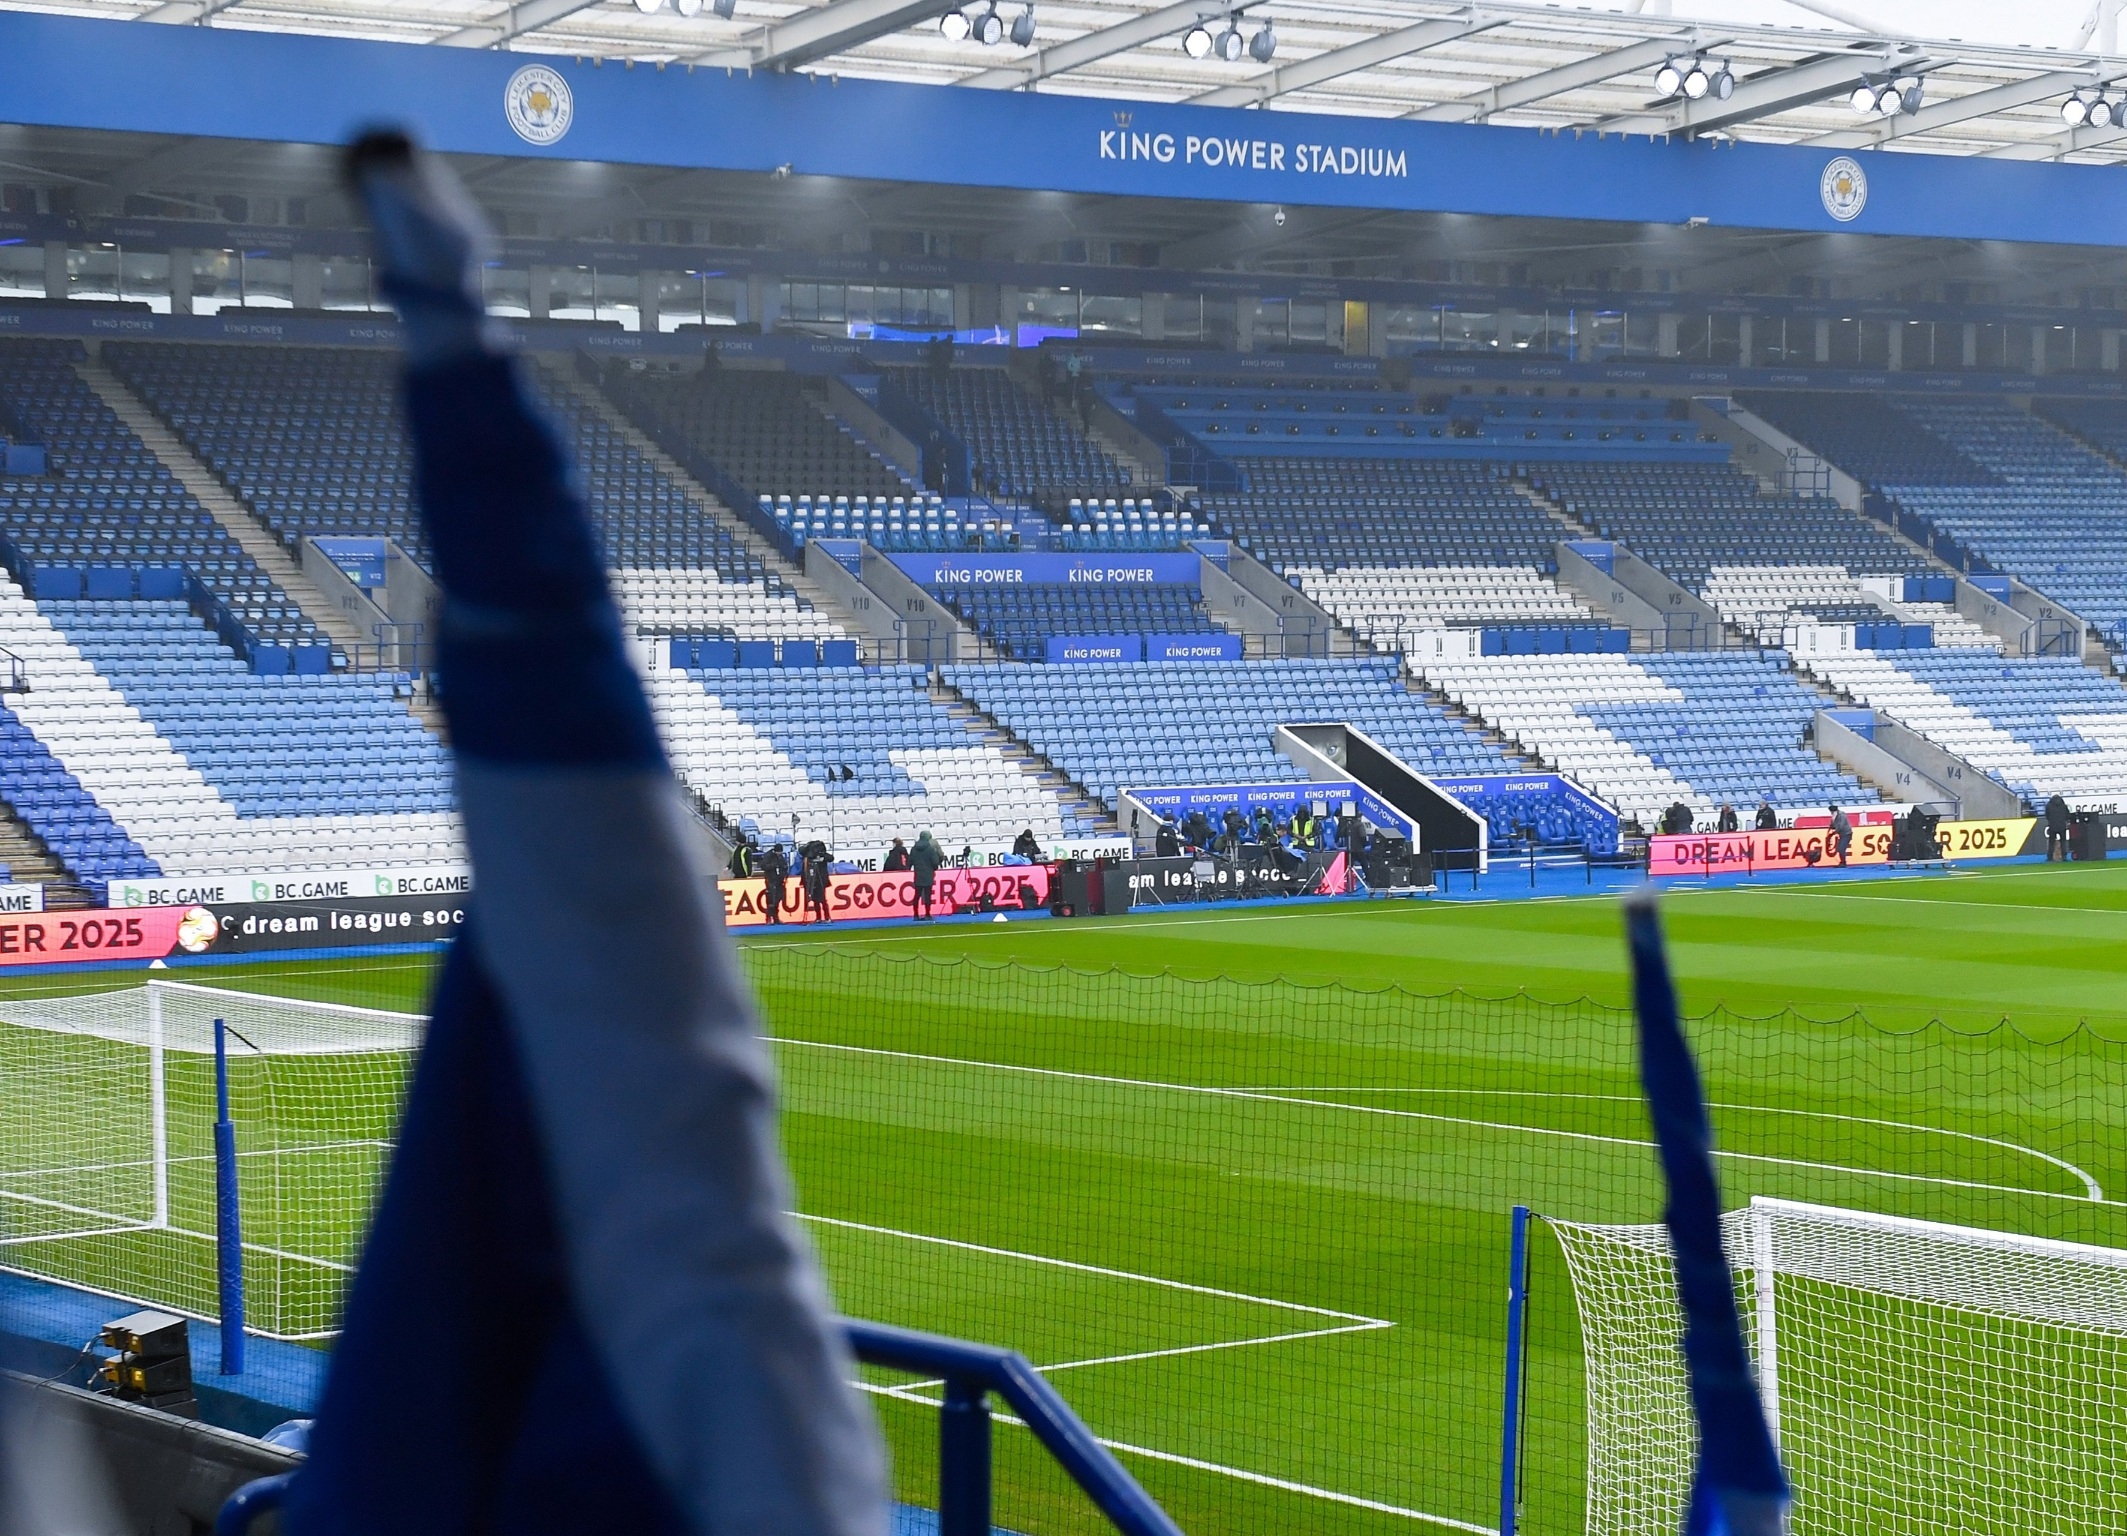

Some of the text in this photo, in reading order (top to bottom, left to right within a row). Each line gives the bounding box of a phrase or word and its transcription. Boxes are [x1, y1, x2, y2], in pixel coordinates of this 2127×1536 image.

[1099, 129, 1408, 178] KING POWER STADIUM
[92, 319, 154, 330] KING POWER
[223, 323, 283, 335] KING POWER
[349, 329, 374, 338] KING
[588, 336, 641, 346] KING POWER
[725, 341, 753, 350] POWER
[811, 344, 860, 353] KING POWER
[1146, 357, 1191, 366] KING POWER
[1241, 359, 1285, 368] KING POWER
[1334, 361, 1377, 370] KING POWER
[935, 568, 1023, 583] KING POWER
[1069, 568, 1153, 582] KING POWER
[342, 595, 358, 610] V12
[852, 597, 870, 610] V10
[1233, 595, 1246, 607] V7
[1281, 595, 1294, 607] V7
[1611, 592, 1624, 603] V5
[1668, 593, 1682, 605] V5
[906, 599, 925, 612] V10
[1983, 604, 1997, 616] V2
[2038, 607, 2052, 619] V2
[1064, 648, 1121, 659] KING POWER
[1166, 646, 1221, 657] KING POWER
[1896, 772, 1911, 786] V4
[1946, 766, 1961, 780] V4
[1458, 784, 1484, 793] POWER
[1505, 781, 1549, 792] KING POWER
[1153, 795, 1181, 805] POWER
[1190, 793, 1238, 803] KING POWER
[1247, 791, 1295, 801] KING POWER
[1304, 789, 1351, 800] KING POWER
[1361, 795, 1378, 813] KING
[1564, 791, 1604, 823] KING POWER
[2076, 803, 2118, 814] BCGAME
[1673, 837, 1755, 866] DREAM
[1958, 827, 2007, 851] 2025
[1071, 847, 1130, 861] BCGAME
[275, 881, 349, 899] BC.GAME
[397, 876, 469, 894] BC.GAME
[148, 887, 225, 905] BC.GAME
[242, 914, 320, 935] dream
[330, 910, 412, 933] league
[0, 918, 145, 953] ER 2025
